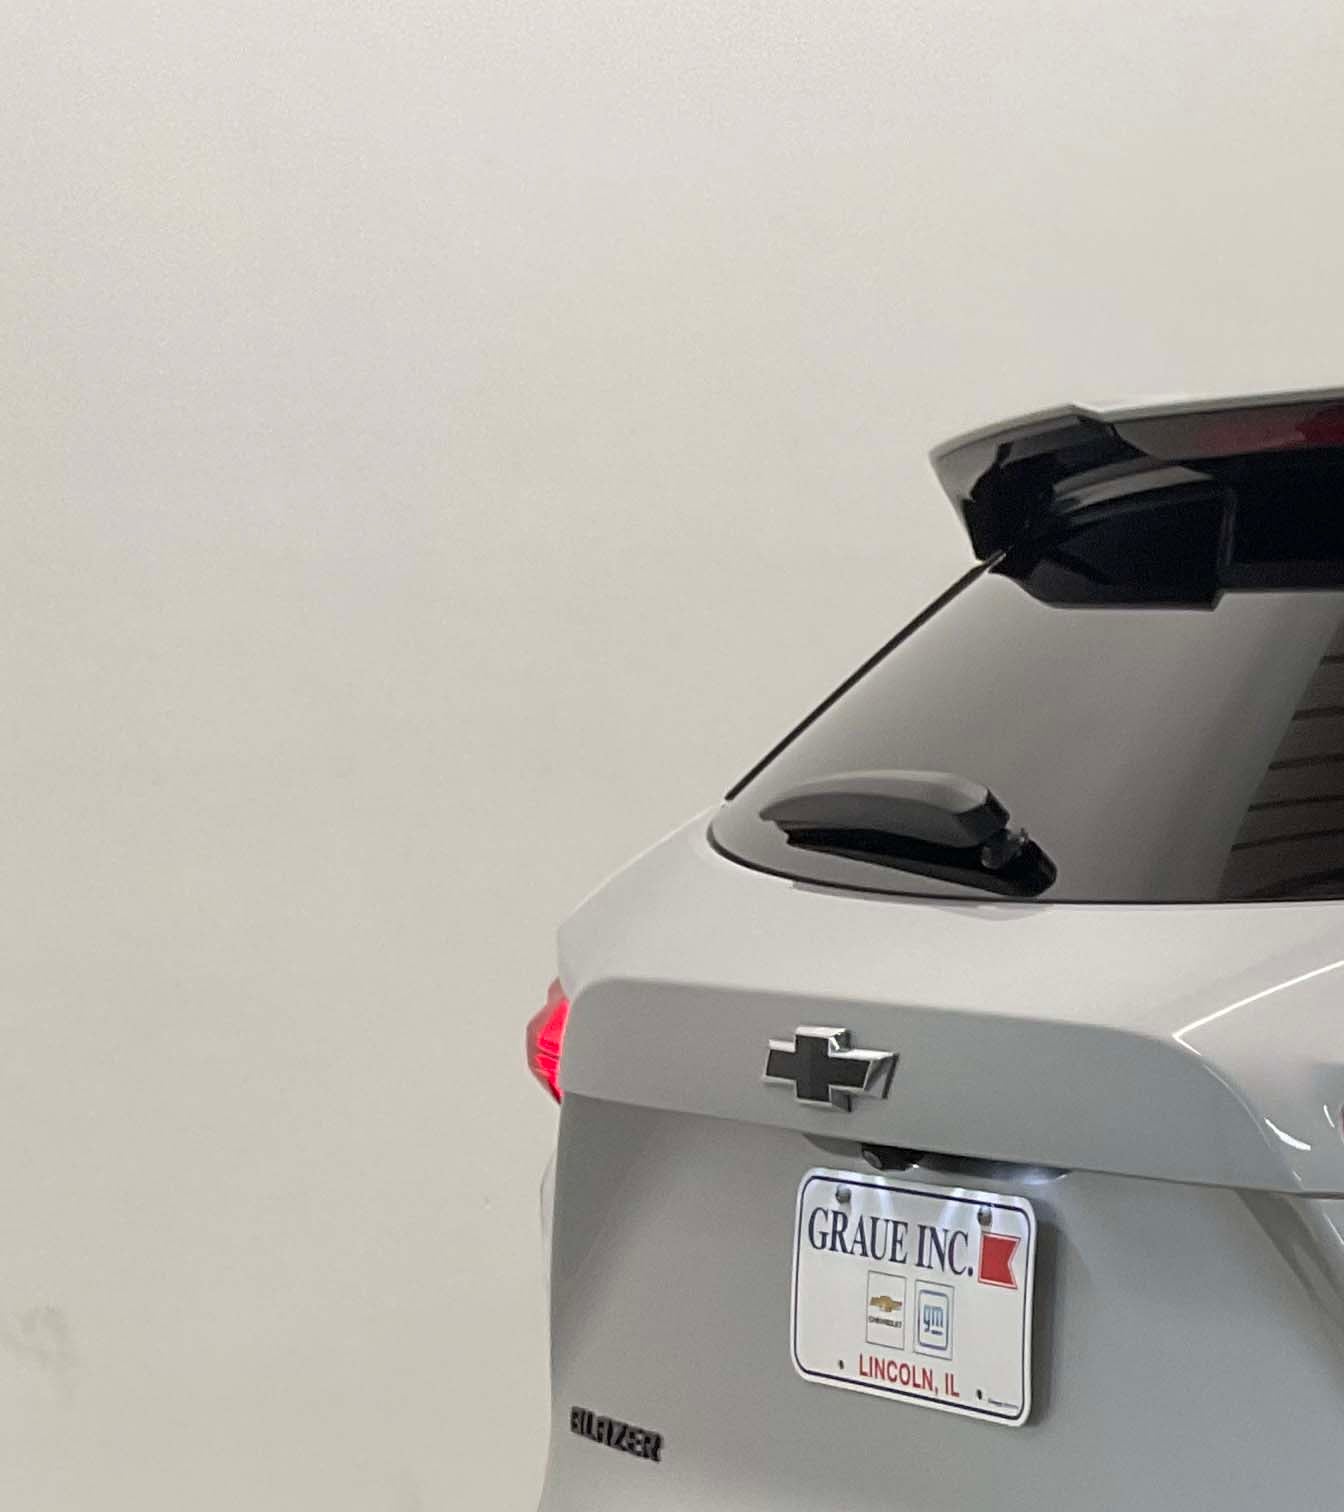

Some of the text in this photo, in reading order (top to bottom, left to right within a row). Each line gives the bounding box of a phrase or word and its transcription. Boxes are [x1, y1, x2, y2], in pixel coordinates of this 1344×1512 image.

[808, 1207, 973, 1277] GRAUE INC.
[859, 1353, 960, 1397] LINCOLN, IL
[570, 1405, 663, 1463] BLAZER
